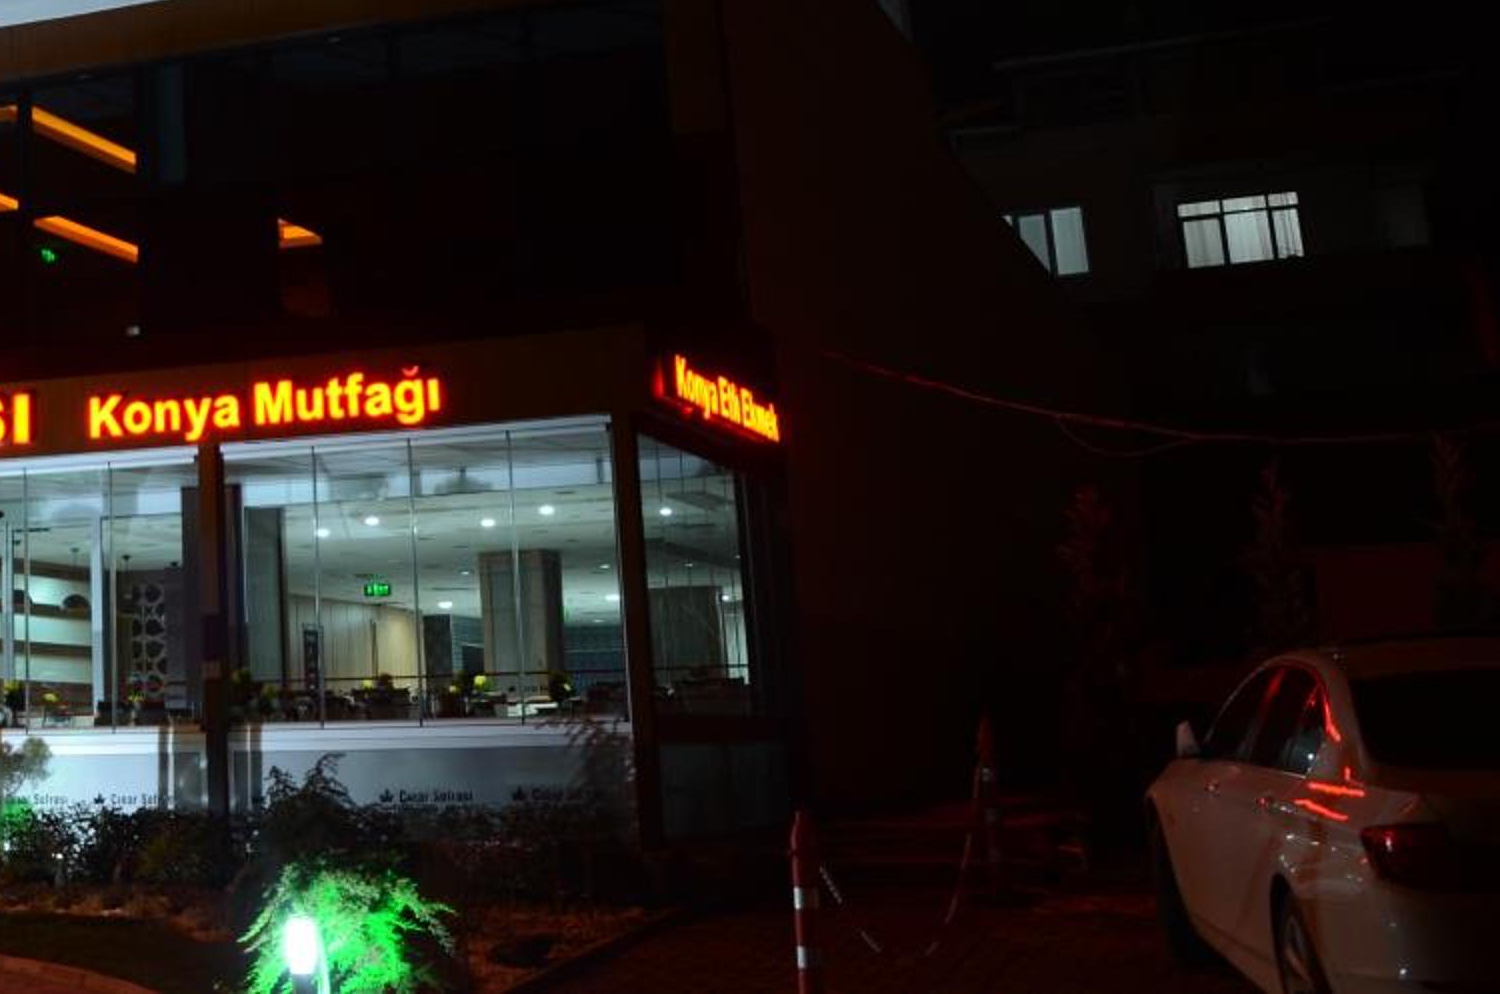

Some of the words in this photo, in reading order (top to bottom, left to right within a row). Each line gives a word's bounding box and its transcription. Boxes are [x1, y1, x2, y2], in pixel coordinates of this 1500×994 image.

[88, 394, 241, 442] Konya
[253, 365, 442, 426] Mutfağı
[675, 354, 719, 419] Konya
